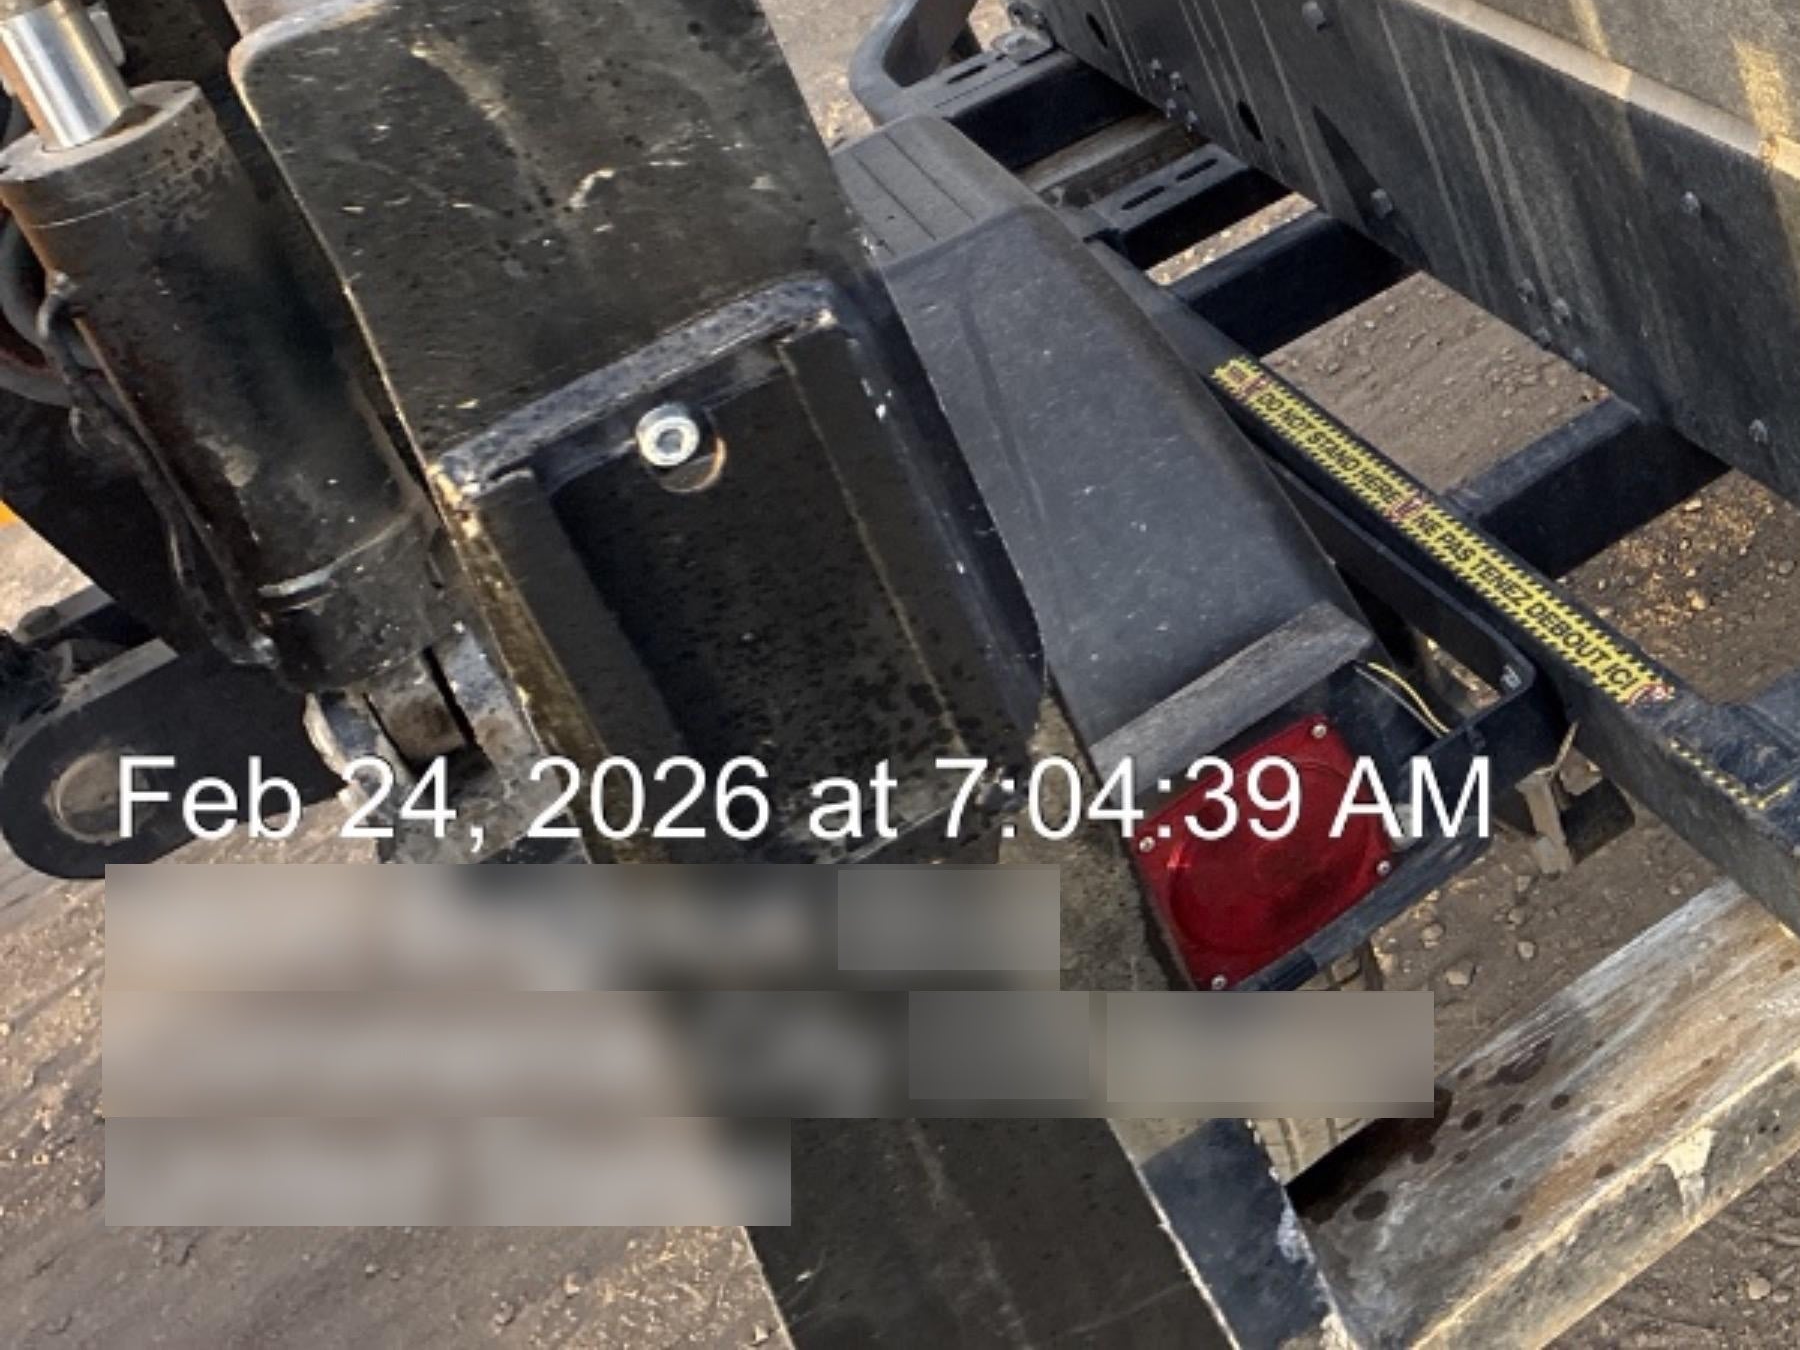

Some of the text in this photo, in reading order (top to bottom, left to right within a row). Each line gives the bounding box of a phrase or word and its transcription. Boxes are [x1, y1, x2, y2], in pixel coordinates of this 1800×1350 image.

[1306, 430, 1361, 473] STAND
[1436, 532, 1477, 563] PAS
[1470, 556, 1534, 607] TENEZ
[1524, 600, 1612, 667] DEBOUT
[1601, 662, 1639, 691] ICI
